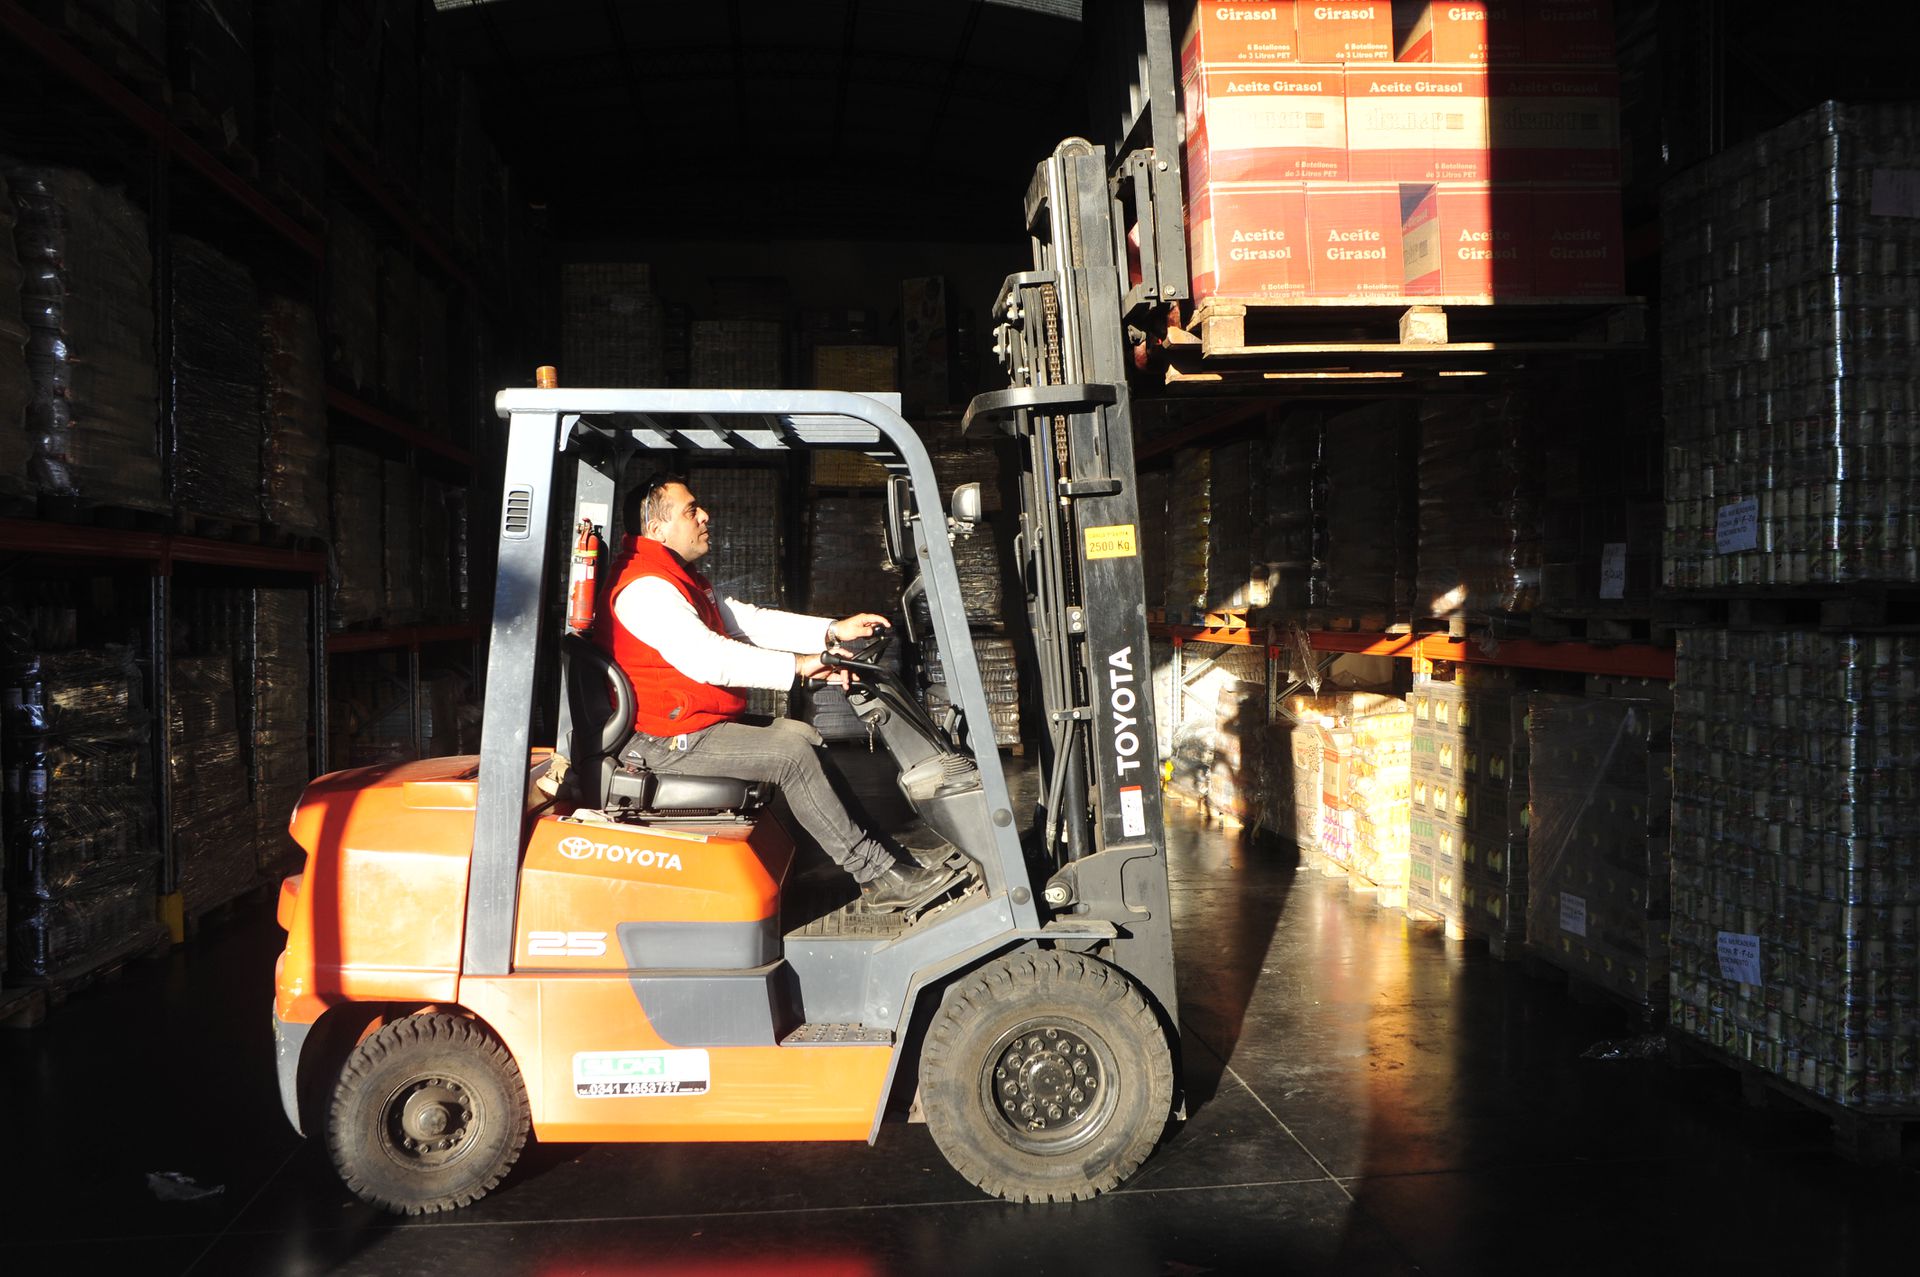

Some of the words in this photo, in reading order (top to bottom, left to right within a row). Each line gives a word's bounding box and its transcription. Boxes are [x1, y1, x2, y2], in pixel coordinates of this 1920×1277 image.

[1216, 8, 1277, 21] Girasol
[1314, 7, 1375, 20] Girasol
[1448, 8, 1507, 21] Girasol
[1253, 43, 1290, 51] Botellones
[1226, 81, 1270, 93] Aceite
[1273, 80, 1322, 92] Girasol
[1369, 82, 1412, 92] Aceite
[1414, 81, 1463, 93] Girasol
[1301, 161, 1337, 169] Botellones
[1441, 162, 1477, 170] Botellones
[1231, 229, 1285, 243] Aceite
[1327, 229, 1380, 242] Aceite
[1459, 228, 1510, 242] Aceite
[1230, 246, 1292, 260] Girasol
[1326, 246, 1386, 260] Girasol
[1457, 247, 1518, 260] Girasol
[1090, 541, 1114, 552] 2500
[1117, 540, 1130, 551] Kg
[1108, 646, 1140, 776] TOYOTA
[594, 843, 682, 871] TOYOTA
[528, 931, 608, 956] 25
[590, 1083, 621, 1095] 0341
